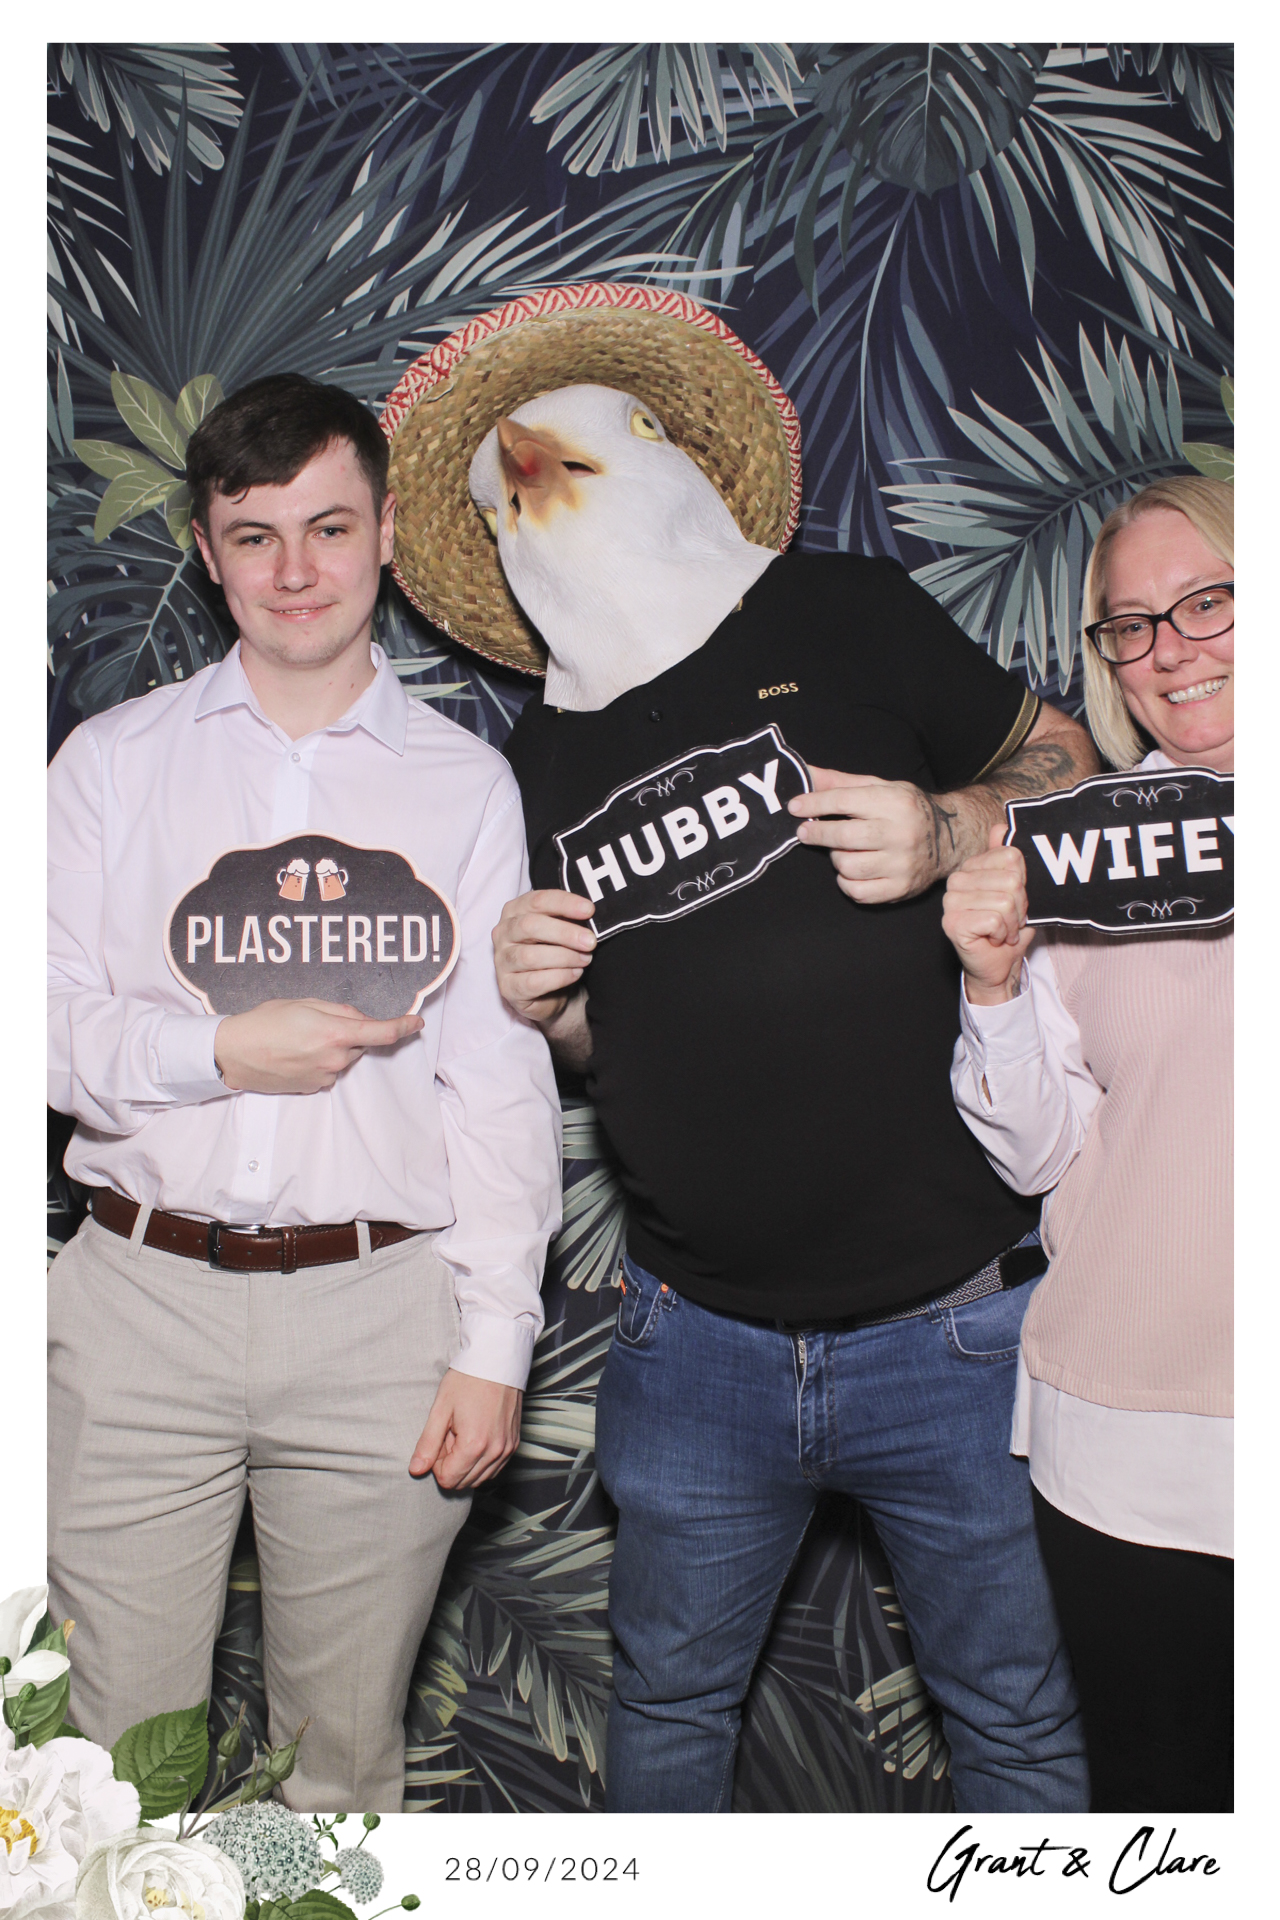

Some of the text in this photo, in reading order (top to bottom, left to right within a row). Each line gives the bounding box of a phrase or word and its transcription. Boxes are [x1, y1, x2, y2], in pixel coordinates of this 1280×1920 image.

[758, 682, 799, 699] BOSS
[575, 758, 783, 903] HUBBY
[1031, 815, 1234, 886] WIFE
[186, 914, 441, 964] PLASTERED!
